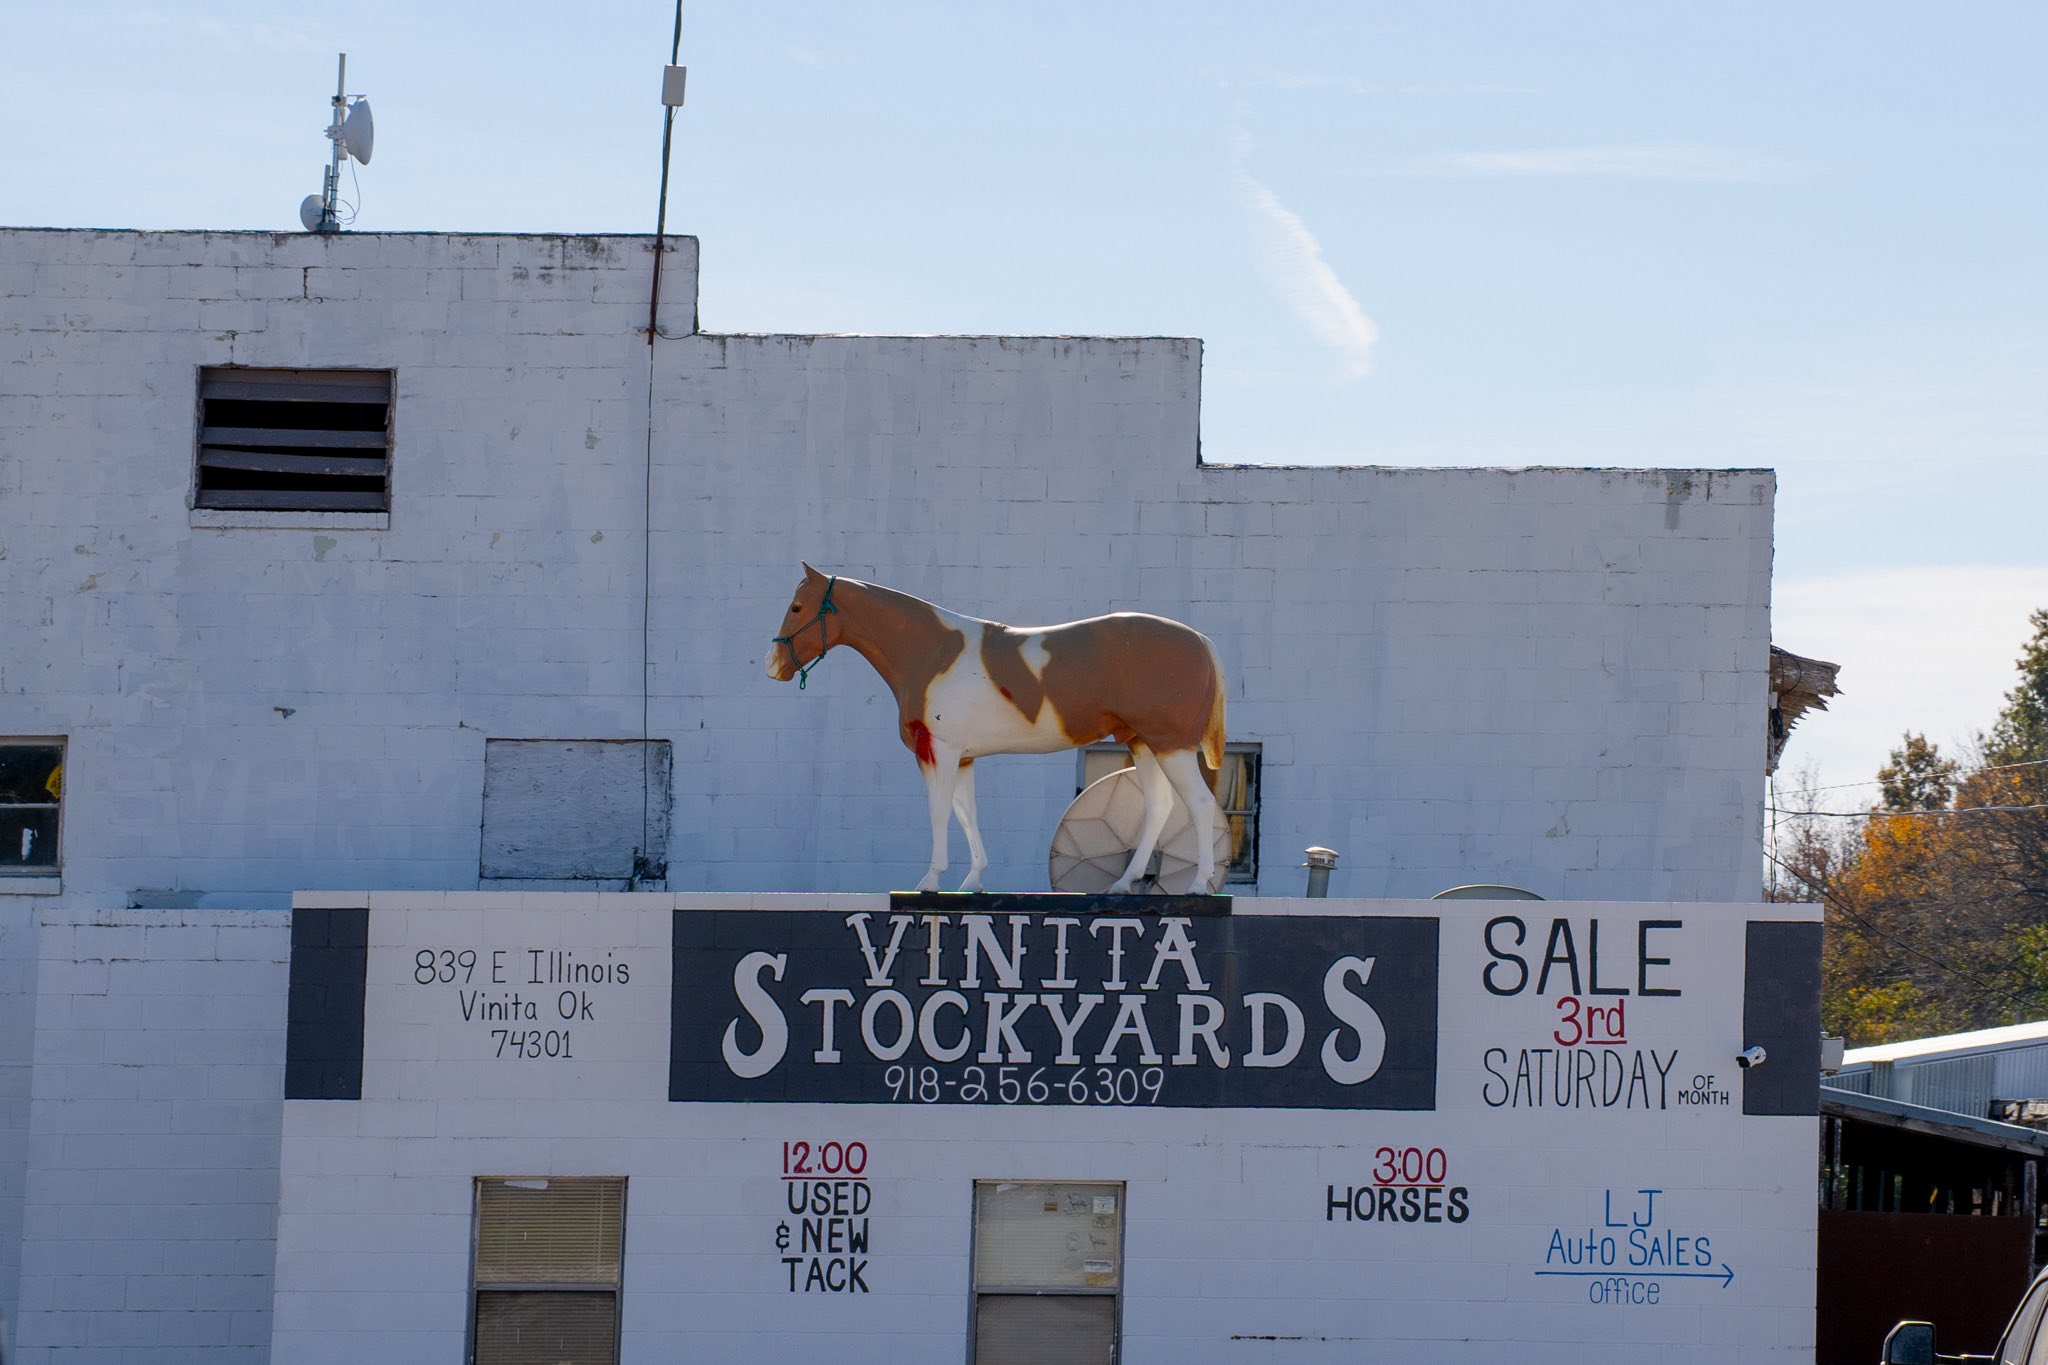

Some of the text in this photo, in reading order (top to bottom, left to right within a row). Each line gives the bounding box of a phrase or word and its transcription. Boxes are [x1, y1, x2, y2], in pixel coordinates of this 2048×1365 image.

[414, 949, 630, 985] 839 E Illinois
[845, 912, 1212, 991] VINITA
[1483, 915, 1683, 997] SALE
[459, 989, 594, 1021] Vinita Ok
[722, 950, 1386, 1085] STOCKYARDS
[1553, 996, 1626, 1046] 3rd
[491, 1029, 573, 1059] 74301
[884, 1065, 1165, 1104] 918-256-6309
[1483, 1048, 1678, 1110] SATURDAY
[1692, 1074, 1715, 1091] OF
[1678, 1090, 1730, 1106] MONTH
[783, 1141, 868, 1174] 12:00
[1373, 1147, 1447, 1182] 3:00
[787, 1181, 871, 1215] USED
[1326, 1185, 1470, 1223] HORSES
[775, 1218, 869, 1254] & NEW
[1546, 1228, 1616, 1266] Auto
[781, 1257, 869, 1293] TACK
